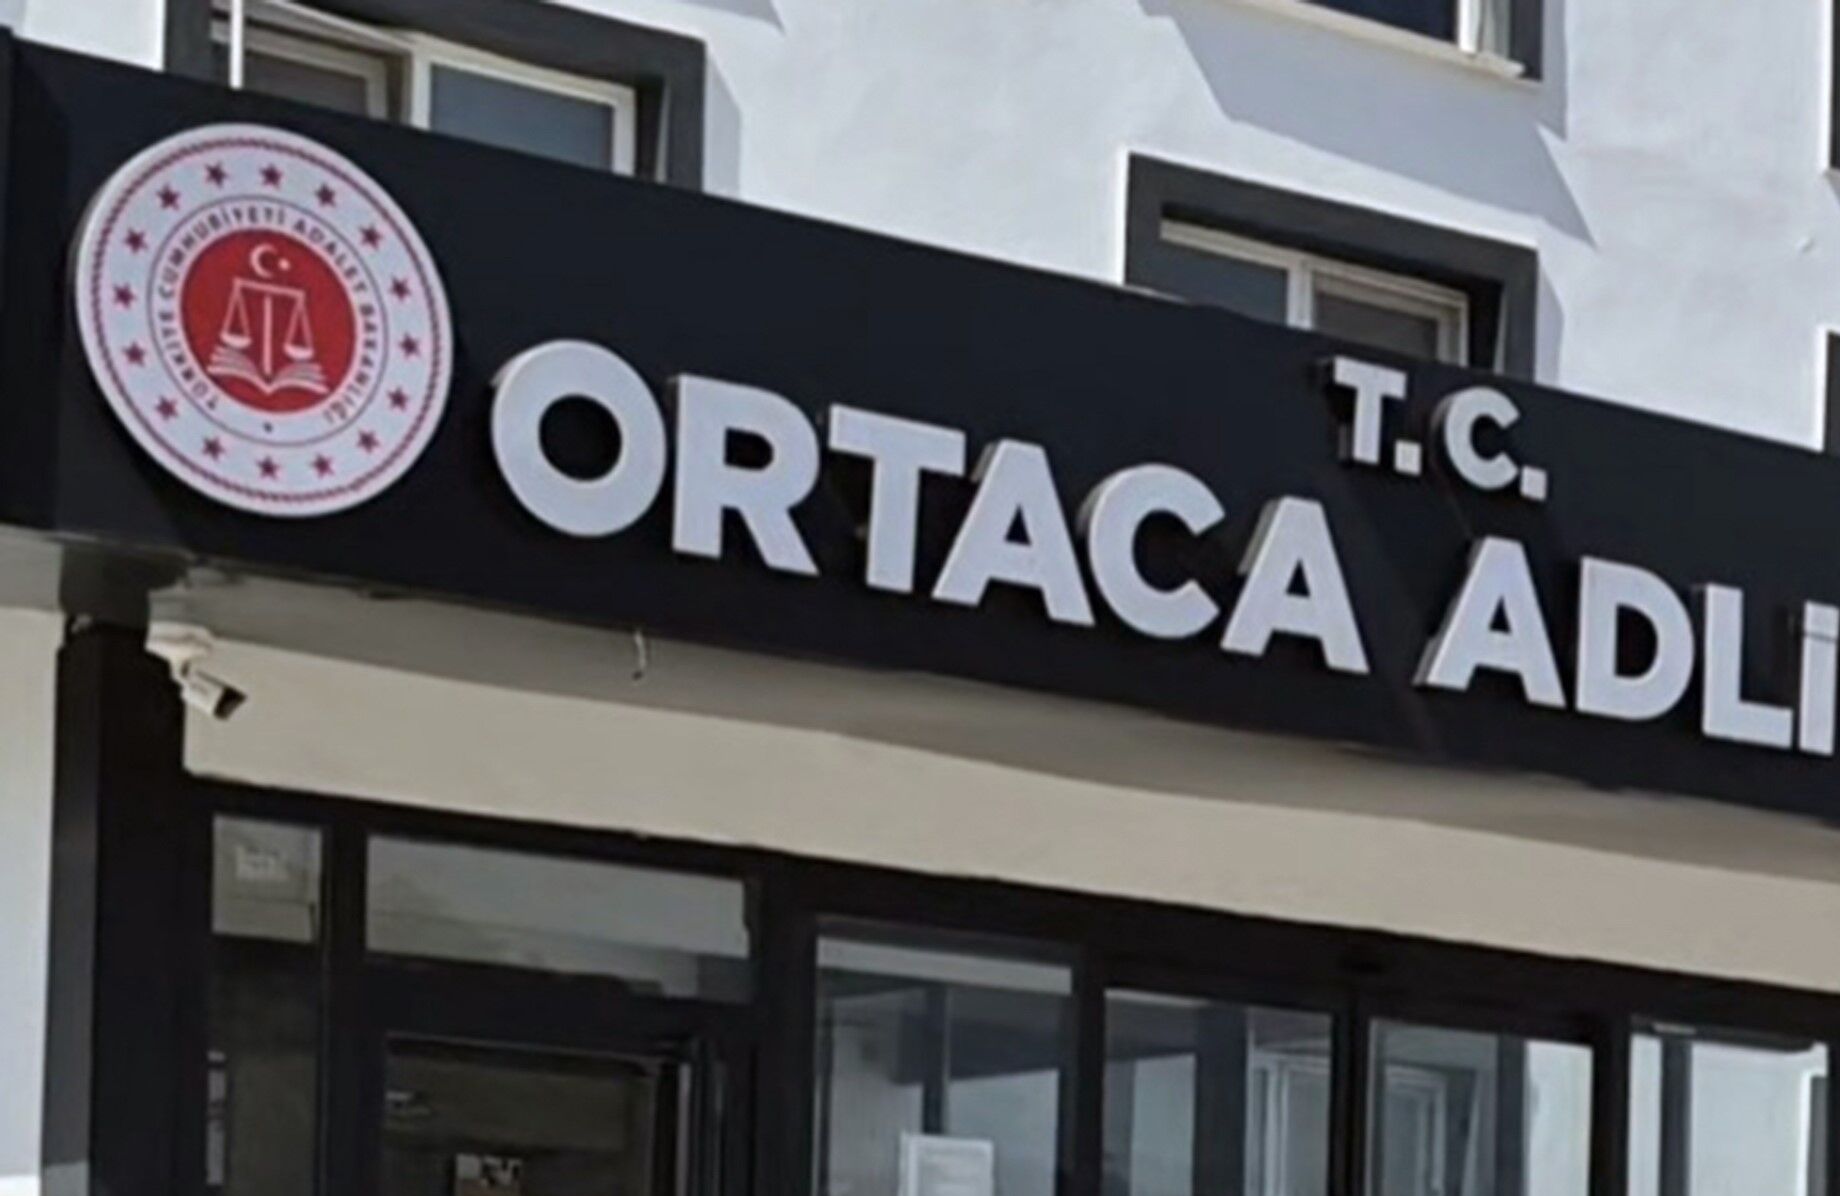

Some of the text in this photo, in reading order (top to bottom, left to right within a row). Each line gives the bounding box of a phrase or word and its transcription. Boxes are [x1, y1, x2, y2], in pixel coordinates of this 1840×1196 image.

[292, 217, 368, 294] ADALET
[1332, 354, 1549, 503] T.C.
[489, 339, 1371, 675] ORTACA
